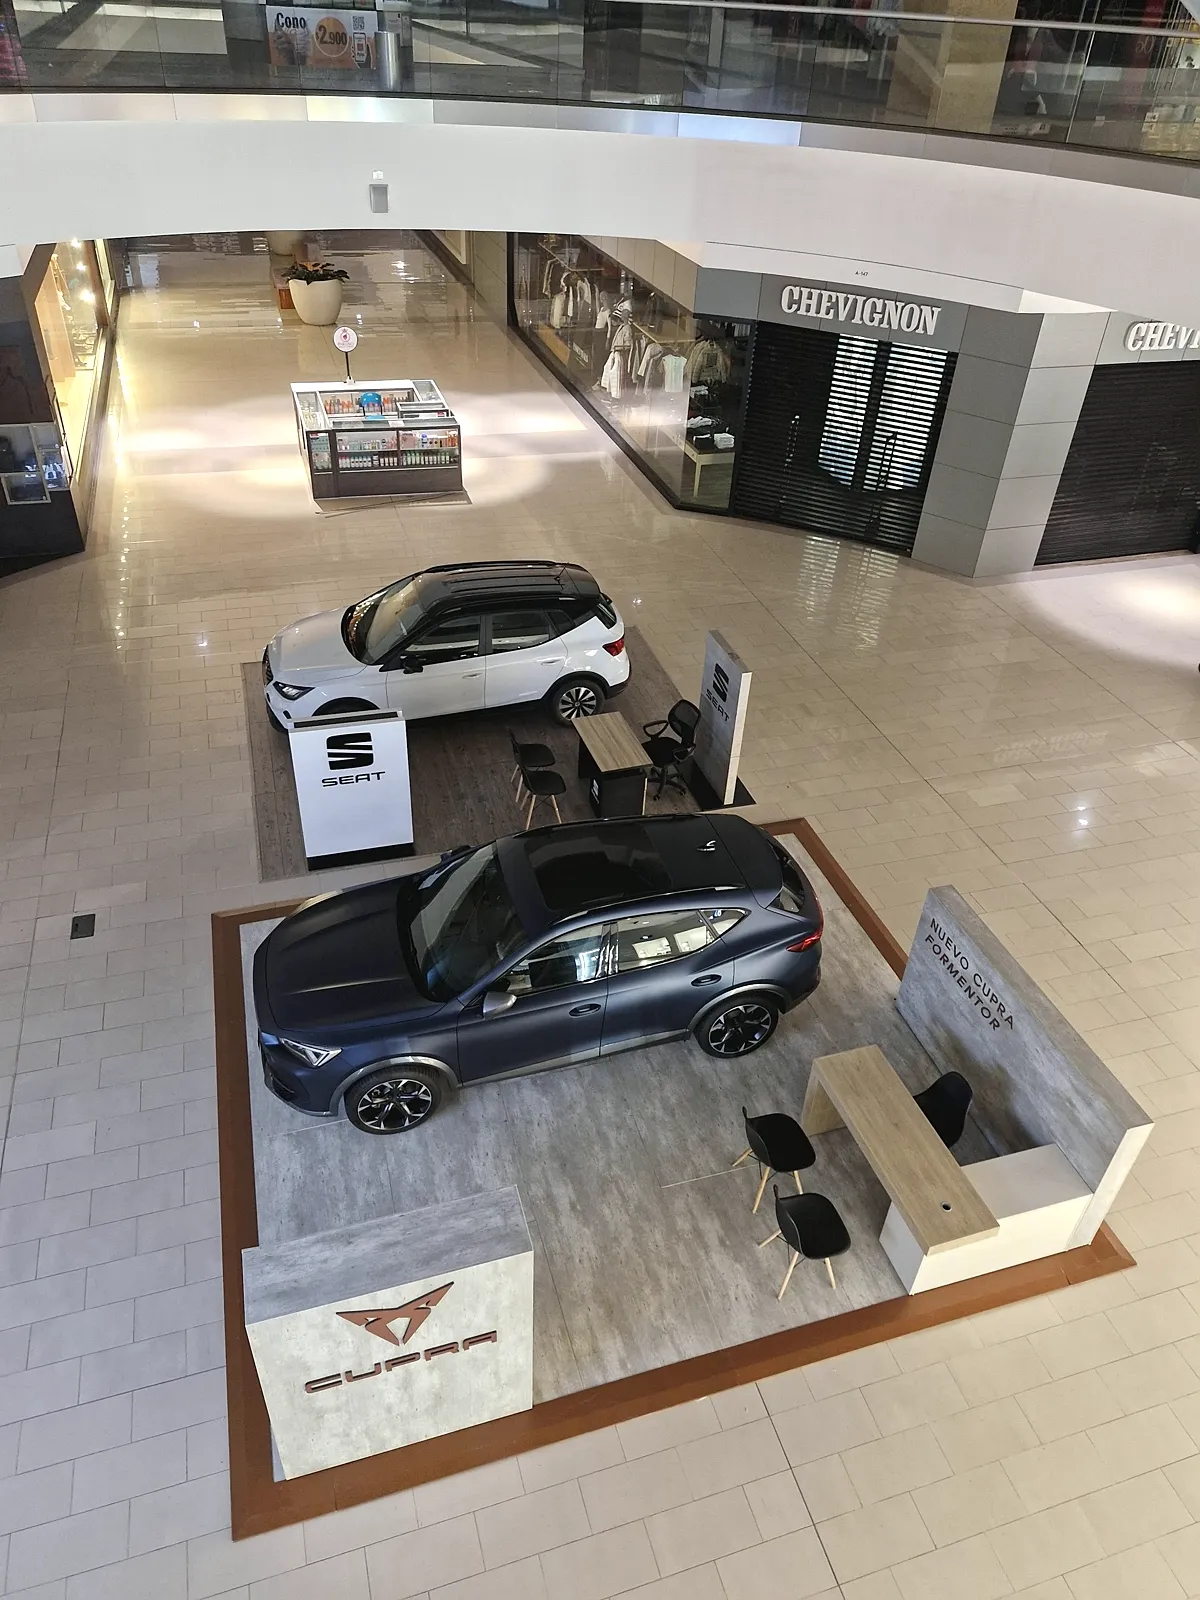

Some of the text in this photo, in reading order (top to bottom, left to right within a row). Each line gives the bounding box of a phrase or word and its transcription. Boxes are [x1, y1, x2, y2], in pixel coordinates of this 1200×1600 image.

[276, 12, 307, 29] Cono
[781, 285, 942, 336] CHEVIGNON
[705, 688, 730, 722] SEAT
[321, 771, 386, 788] SEAT
[924, 934, 1001, 1031] FORMENTOR
[930, 918, 1014, 1030] NUEVO CUPRA
[304, 1330, 497, 1394] CUPRA
